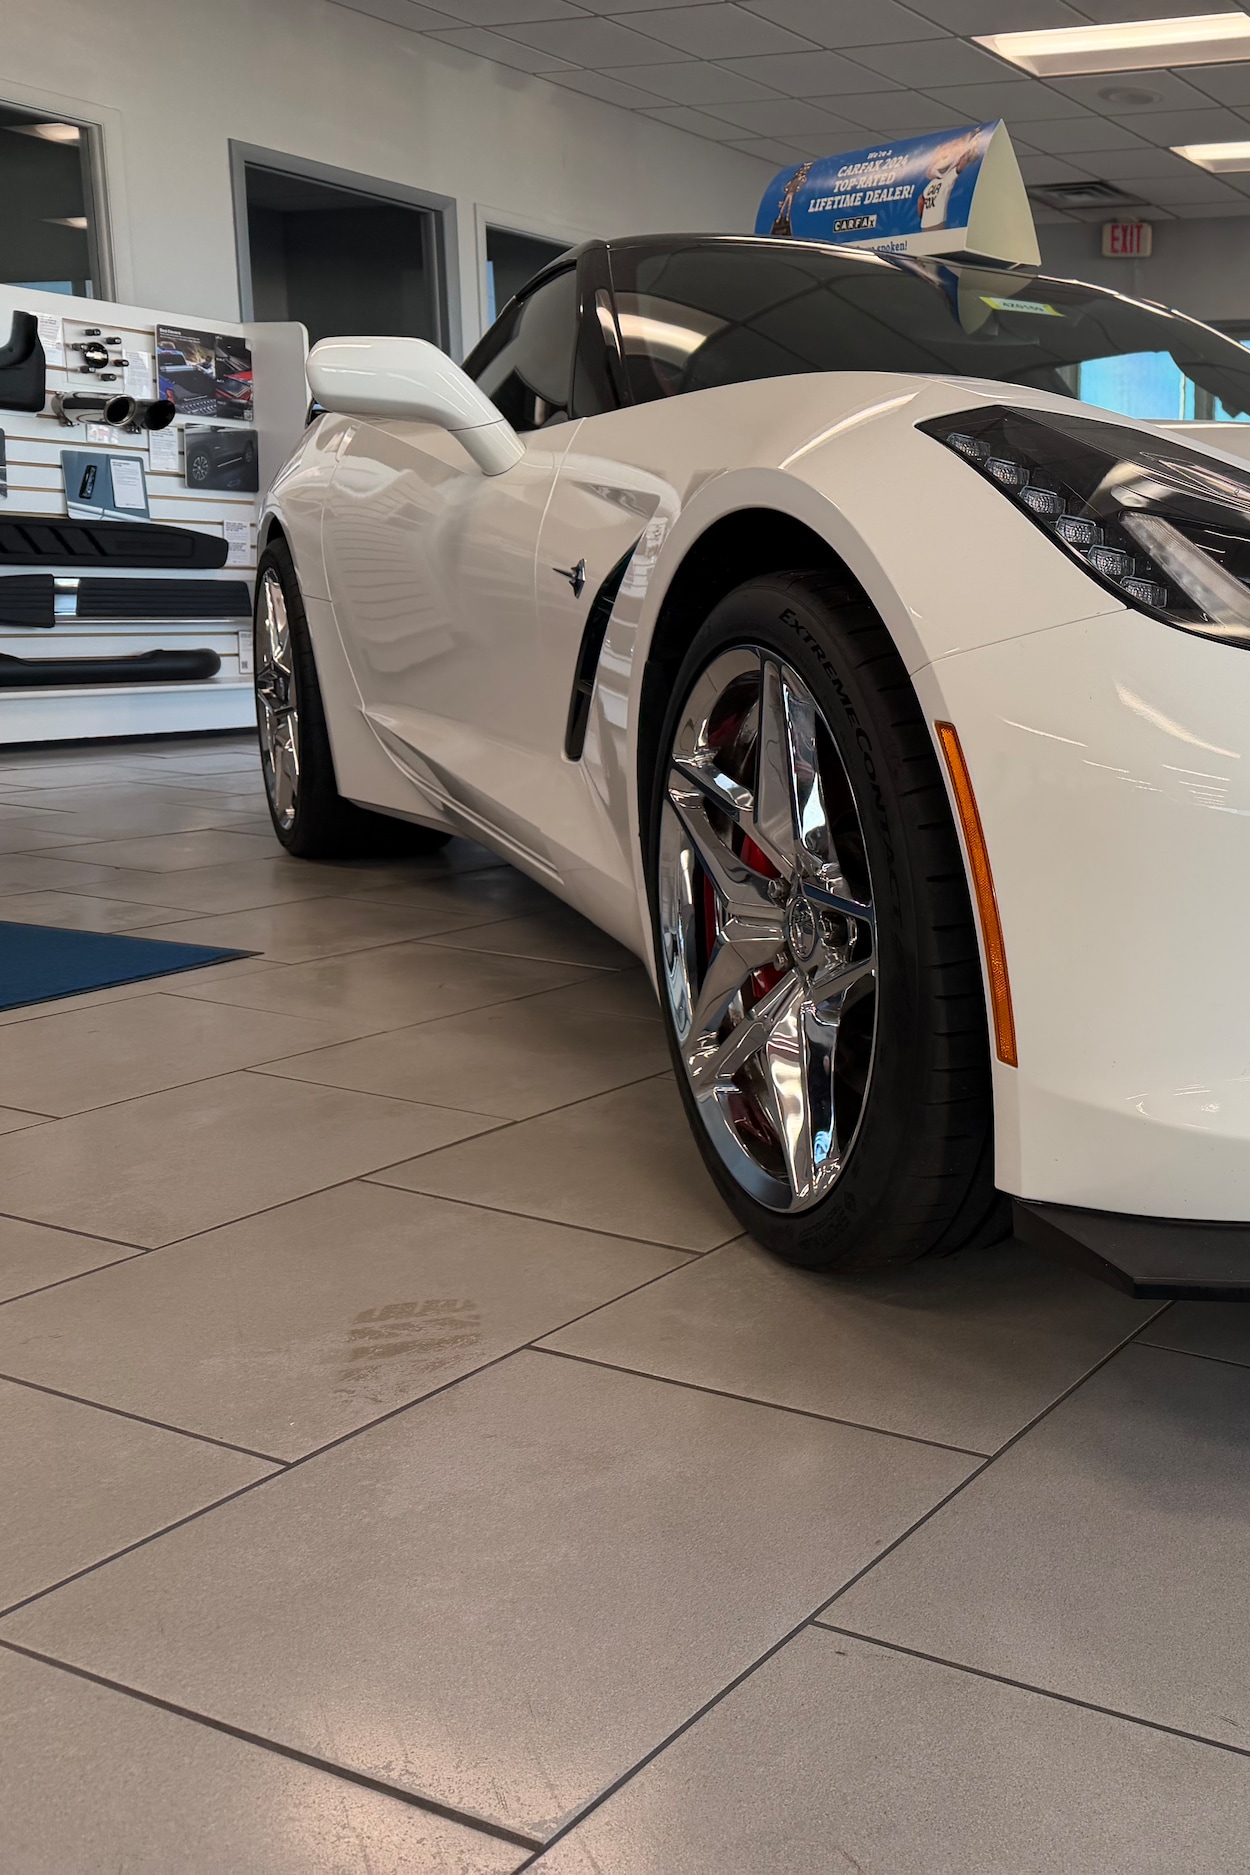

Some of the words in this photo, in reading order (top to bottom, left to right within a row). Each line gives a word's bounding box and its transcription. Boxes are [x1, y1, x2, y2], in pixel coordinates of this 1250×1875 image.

[837, 160, 883, 178] CARFAX
[882, 154, 909, 171] 2024
[833, 172, 896, 193] TOP-RATED
[808, 192, 863, 213] LIFETIME
[864, 184, 915, 205] DEALER!
[834, 215, 877, 232] CARFAX
[1110, 223, 1143, 254] EXIT
